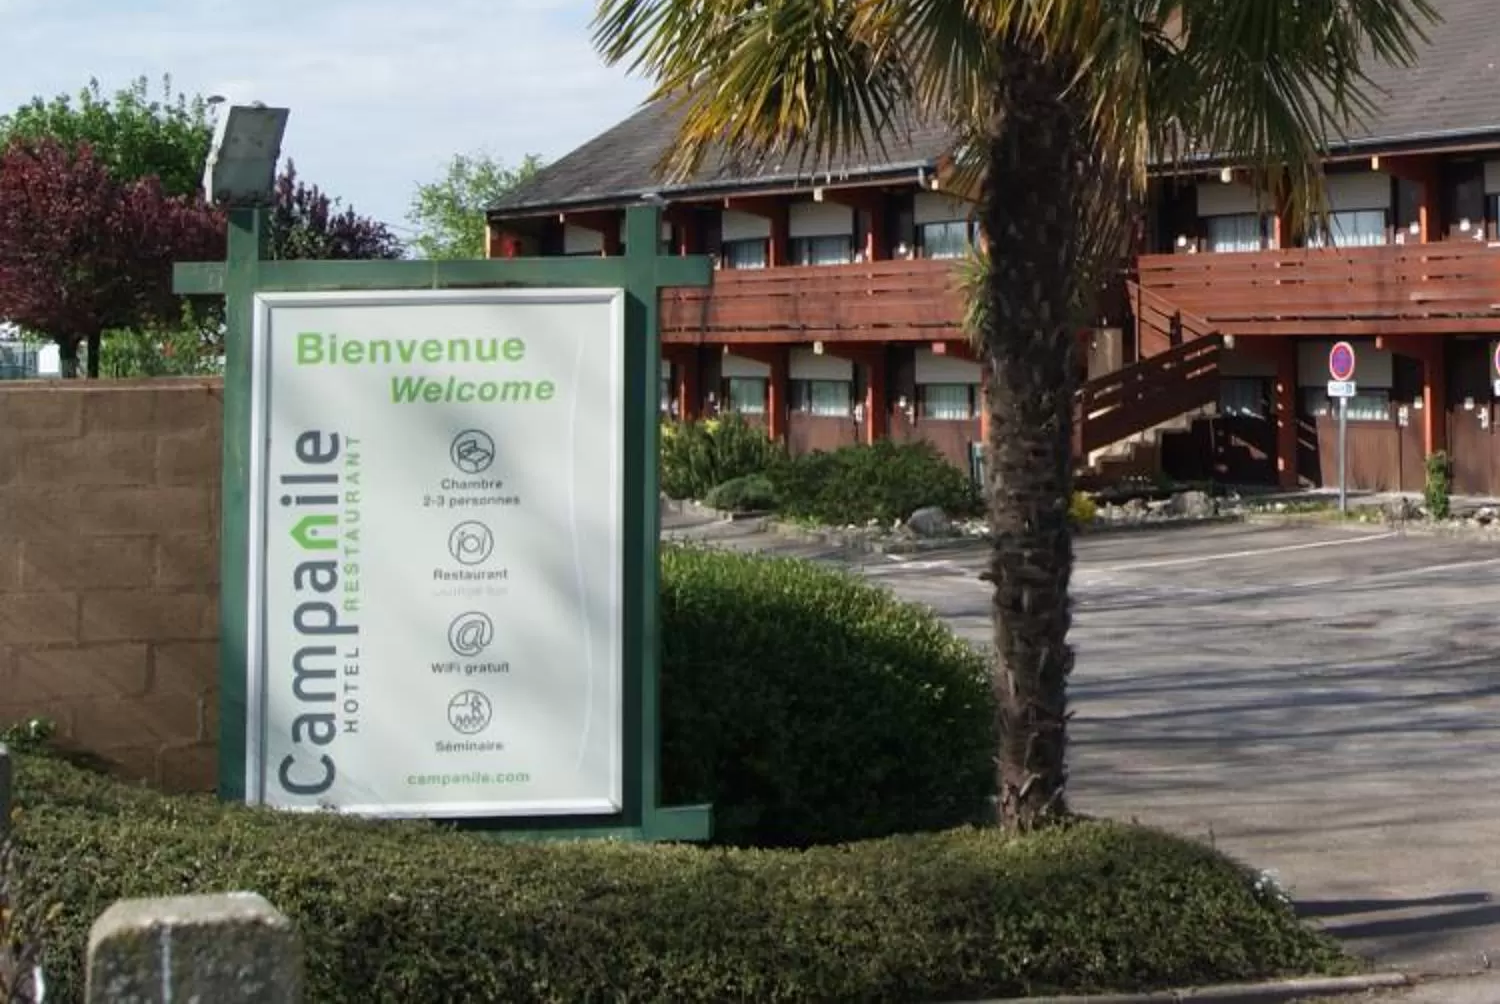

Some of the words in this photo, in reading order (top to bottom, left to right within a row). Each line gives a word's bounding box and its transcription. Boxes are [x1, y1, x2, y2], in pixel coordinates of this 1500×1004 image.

[296, 332, 526, 365] Bienvenue
[390, 375, 556, 404] Welcome
[440, 478, 503, 490] Chambre
[423, 495, 446, 507] 2-3
[449, 496, 521, 508] personnes
[344, 436, 361, 612] RESTAURANT
[433, 568, 509, 581] Restaurant
[277, 429, 360, 796] Campanile
[431, 662, 461, 673] WiFi
[464, 661, 510, 675] gratuit
[343, 647, 360, 733] HOTEL
[407, 771, 531, 786] campanile.com
